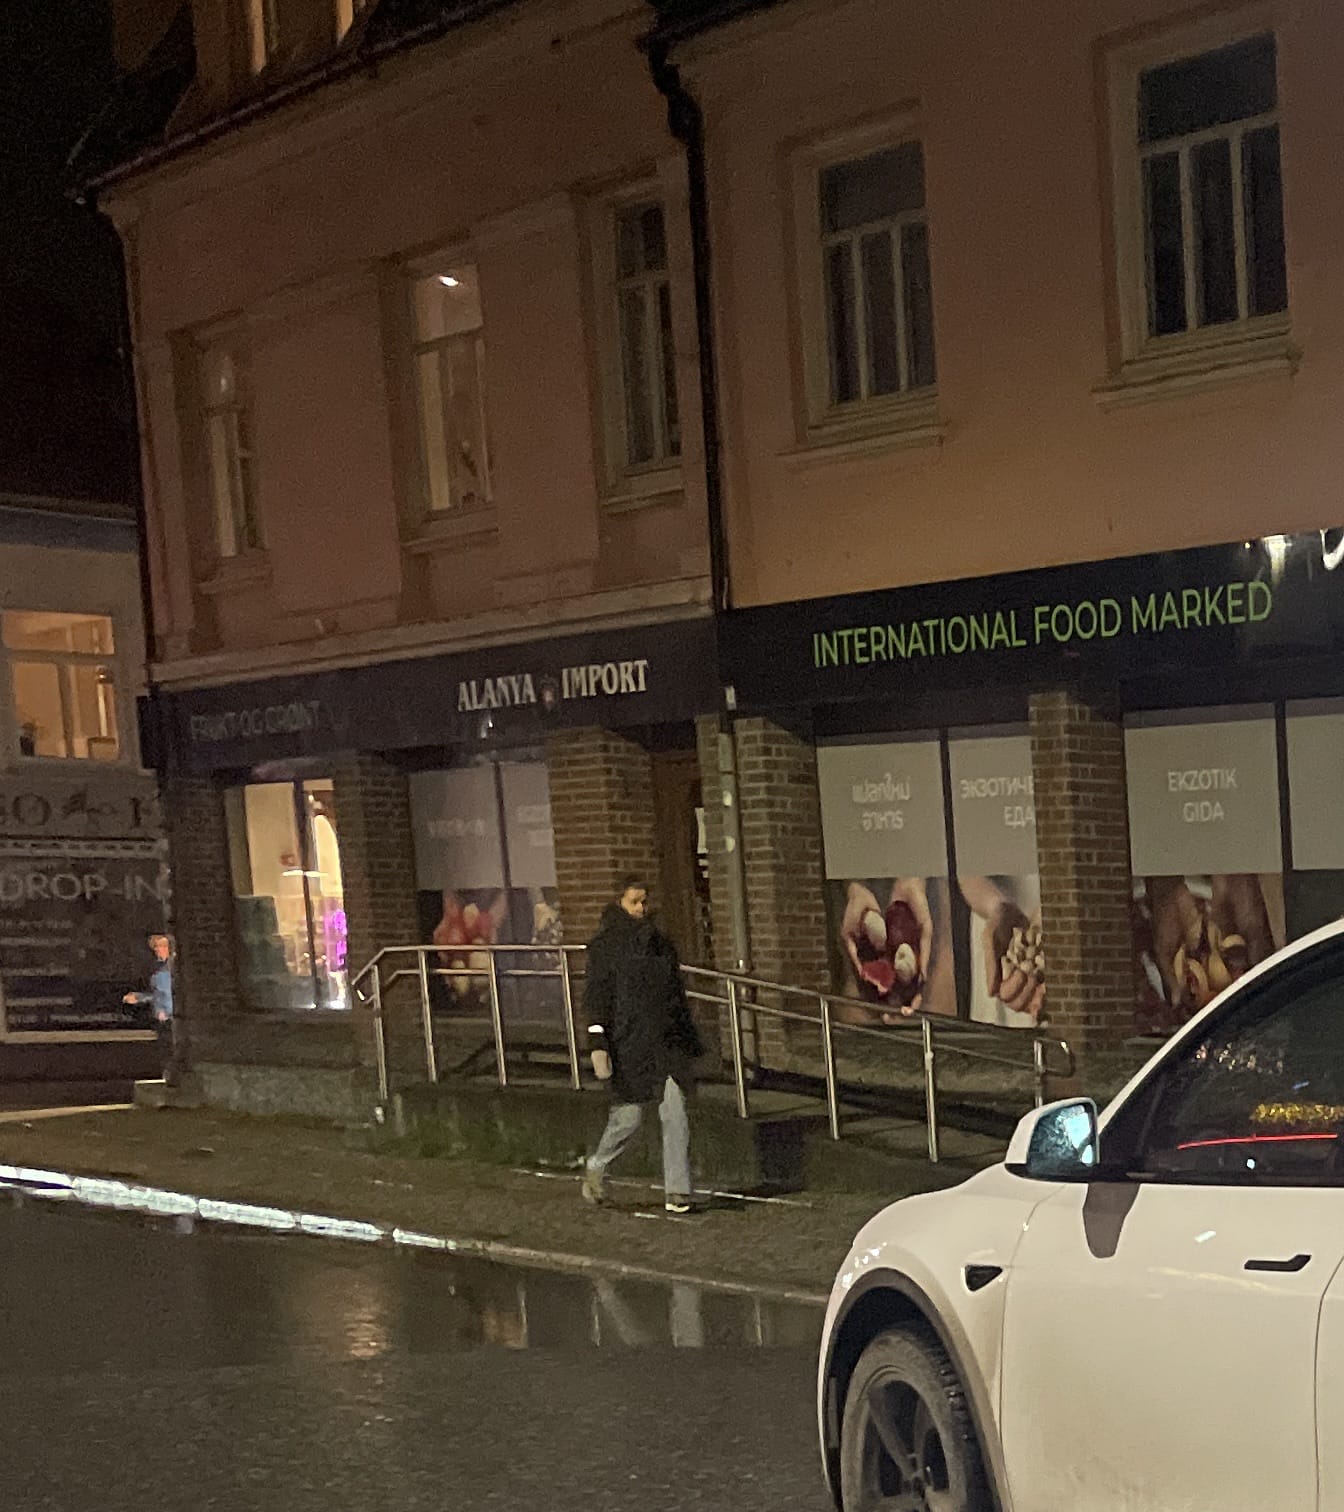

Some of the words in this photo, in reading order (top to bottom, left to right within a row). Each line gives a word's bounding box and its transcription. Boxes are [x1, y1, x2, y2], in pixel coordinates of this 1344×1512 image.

[813, 609, 1027, 667] INTERNATIONAL
[1034, 598, 1122, 644] FOOD
[1131, 580, 1273, 634] MARKED
[458, 673, 538, 712] ALANYA
[562, 659, 648, 699] IMPORT
[960, 775, 1035, 799] ЭКЗОТИЧЕ
[1168, 768, 1238, 792] EKZOTIK
[1183, 801, 1225, 823] GIDA
